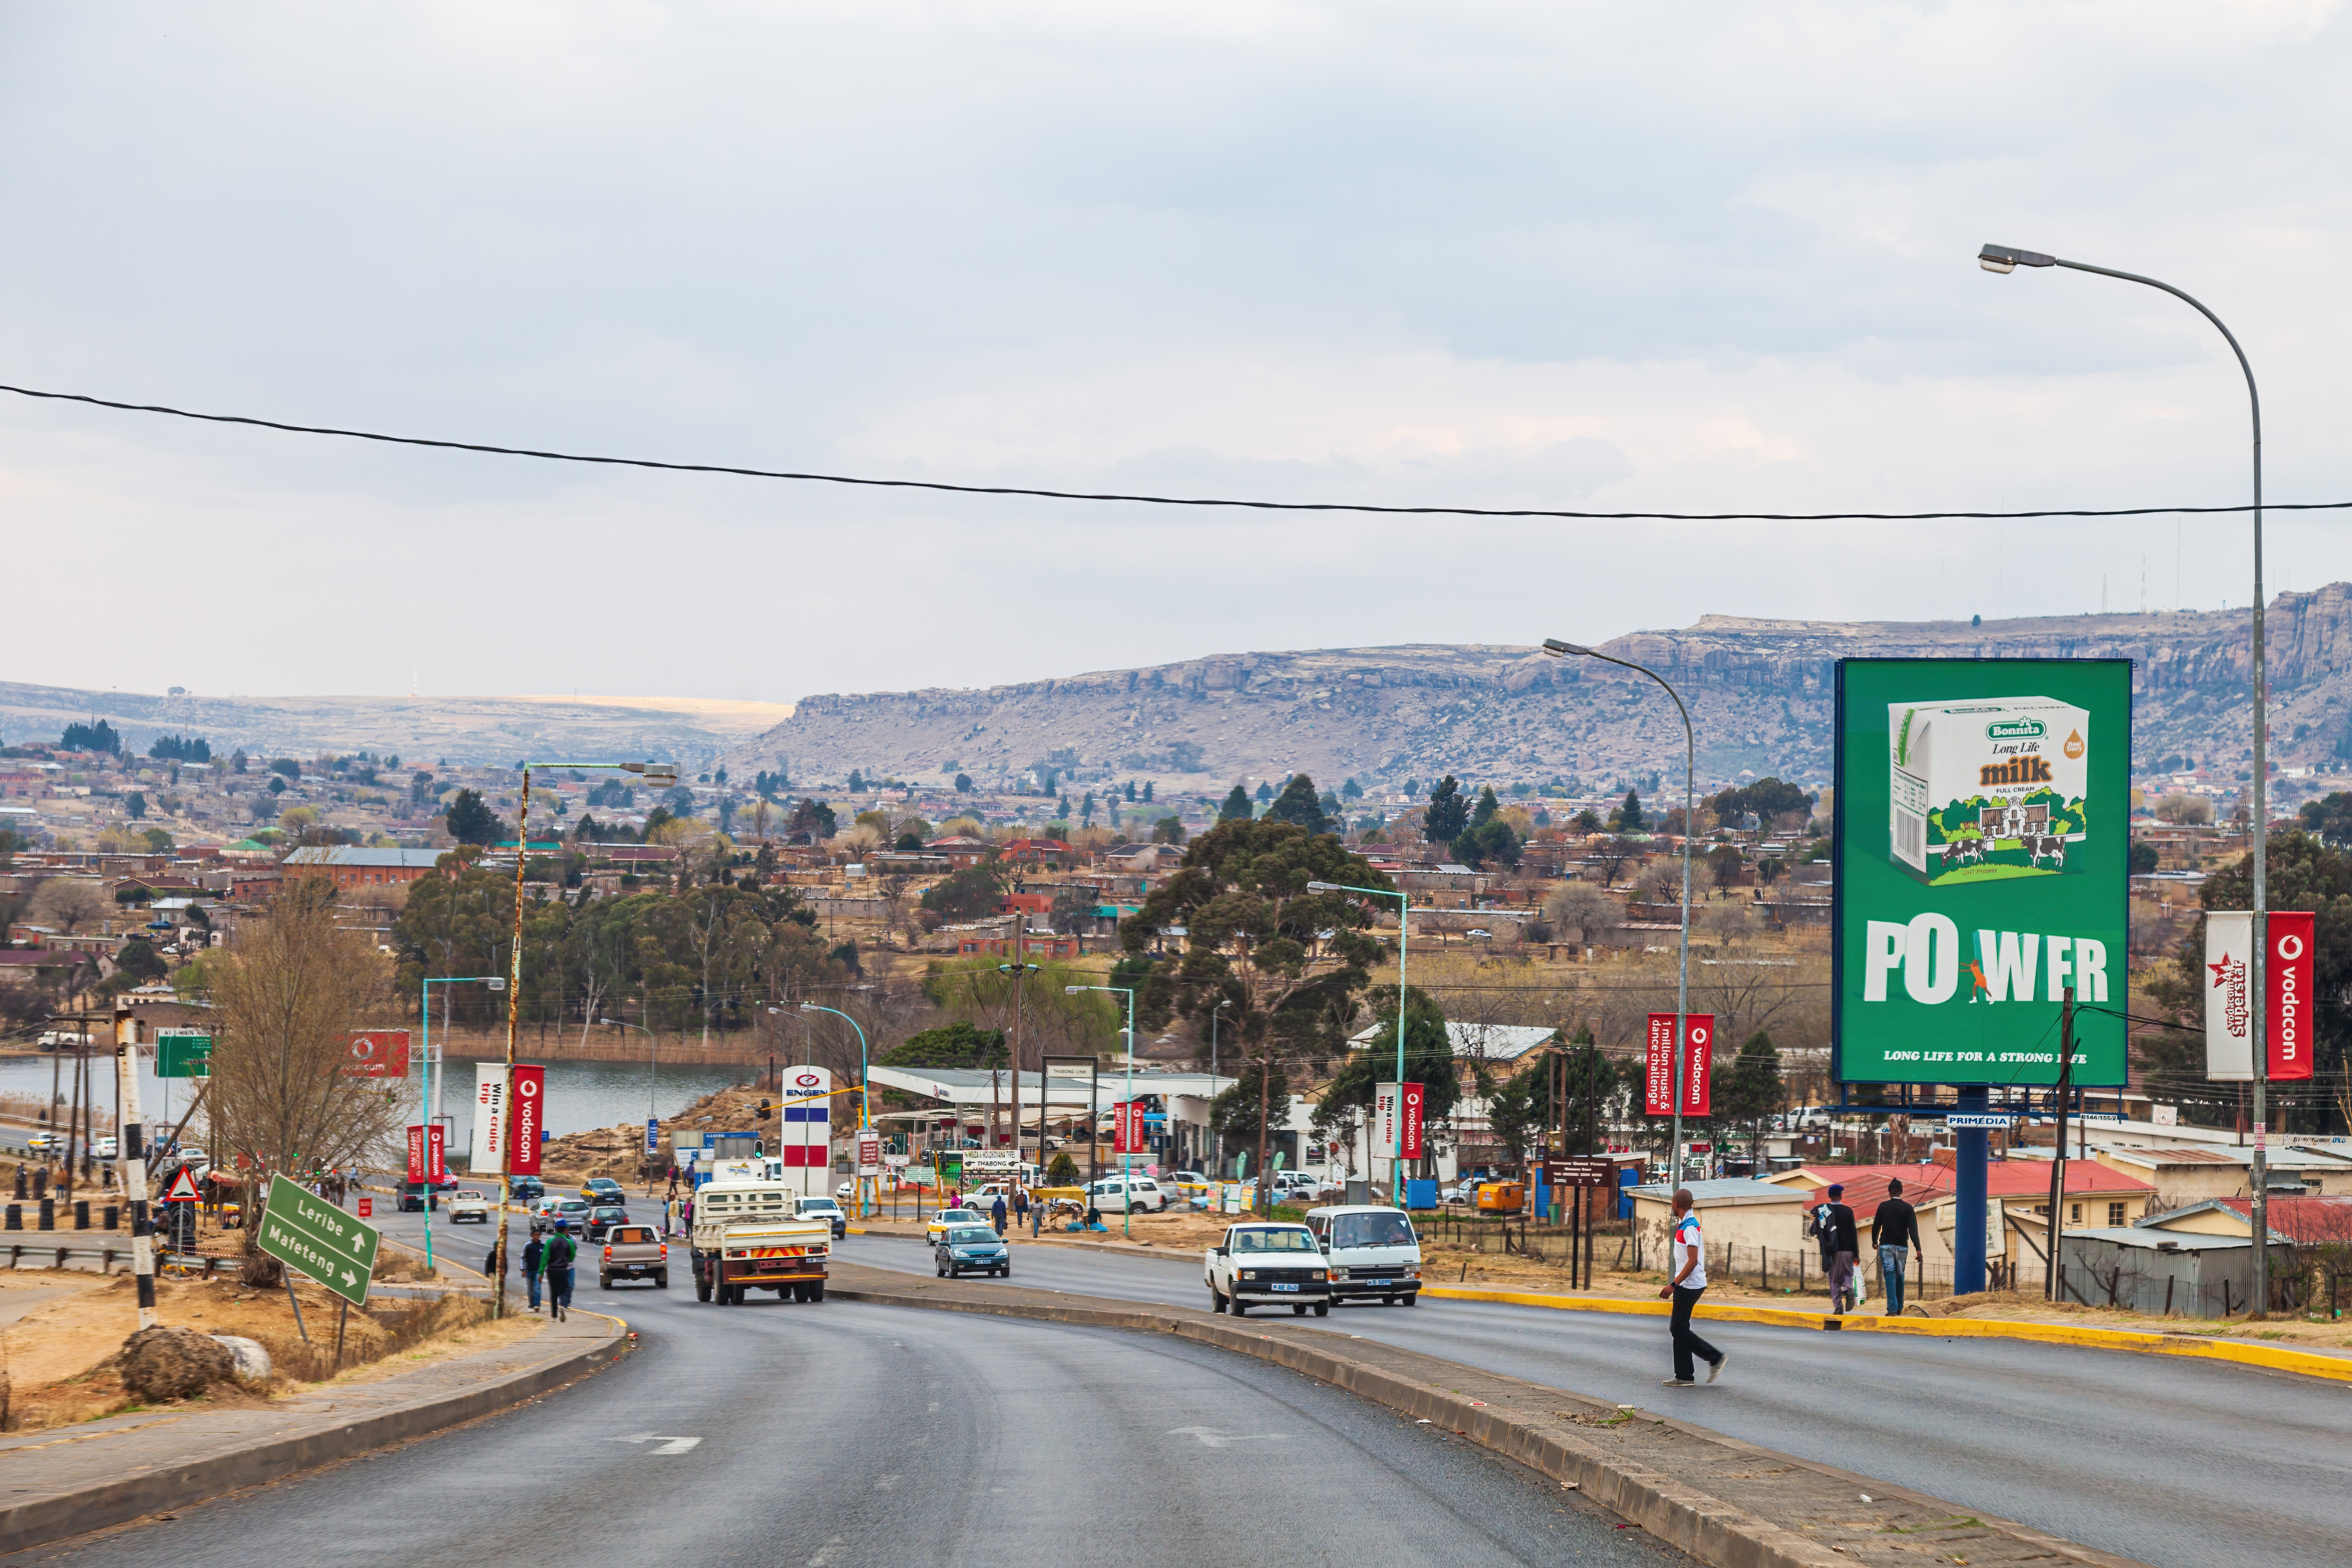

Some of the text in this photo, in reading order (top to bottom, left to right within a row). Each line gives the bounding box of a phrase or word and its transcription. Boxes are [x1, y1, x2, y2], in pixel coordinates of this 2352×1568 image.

[1992, 742, 2040, 755] Long Life
[1993, 725, 2040, 736] Bonnita
[1980, 755, 2053, 787] milk
[1864, 912, 2108, 1004] POWER
[2225, 980, 2235, 1031] vodacom
[2231, 960, 2249, 1038] Superstar
[2282, 966, 2299, 1060] vodacom
[1648, 1020, 1661, 1105] dance challenge
[1661, 1029, 1671, 1065] million
[1884, 1050, 1921, 1061] LONG
[1923, 1051, 1954, 1061] LIFE
[1957, 1052, 1985, 1061] FOR
[1986, 1052, 1996, 1062] A
[1999, 1052, 2053, 1063] STRONG
[479, 1083, 490, 1104] trip
[492, 1083, 502, 1105] Win
[1661, 1068, 1670, 1100] music
[1692, 1047, 1704, 1104] vodacom
[1377, 1096, 1386, 1111] trip
[489, 1116, 499, 1153] cruise
[521, 1101, 534, 1163] vodacom
[1408, 1108, 1417, 1150] vodacom
[297, 1199, 343, 1236] Leribe
[269, 1225, 335, 1277] Mafeteng
